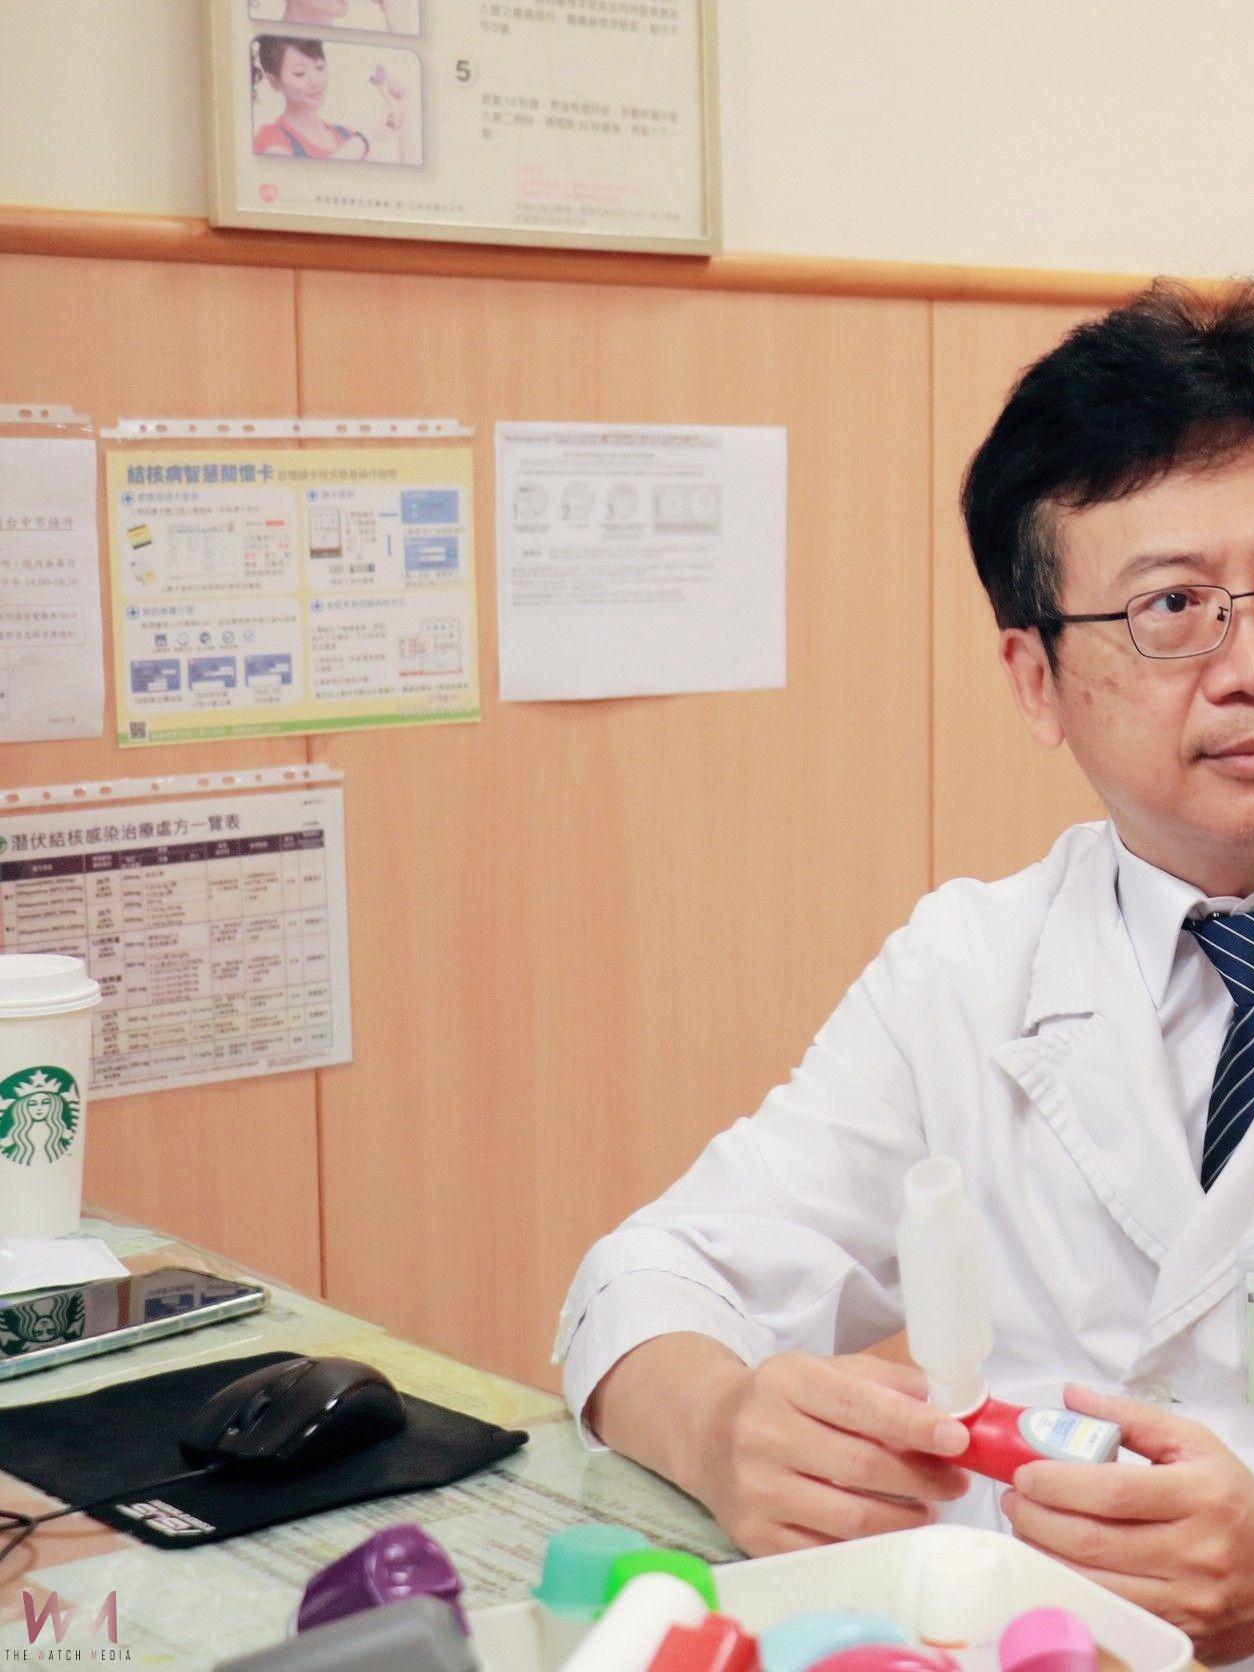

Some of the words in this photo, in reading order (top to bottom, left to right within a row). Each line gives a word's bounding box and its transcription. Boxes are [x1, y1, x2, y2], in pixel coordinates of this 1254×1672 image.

[456, 60, 472, 82] 5
[11, 814, 240, 852] 潛伏結核感染治療處方一覽表
